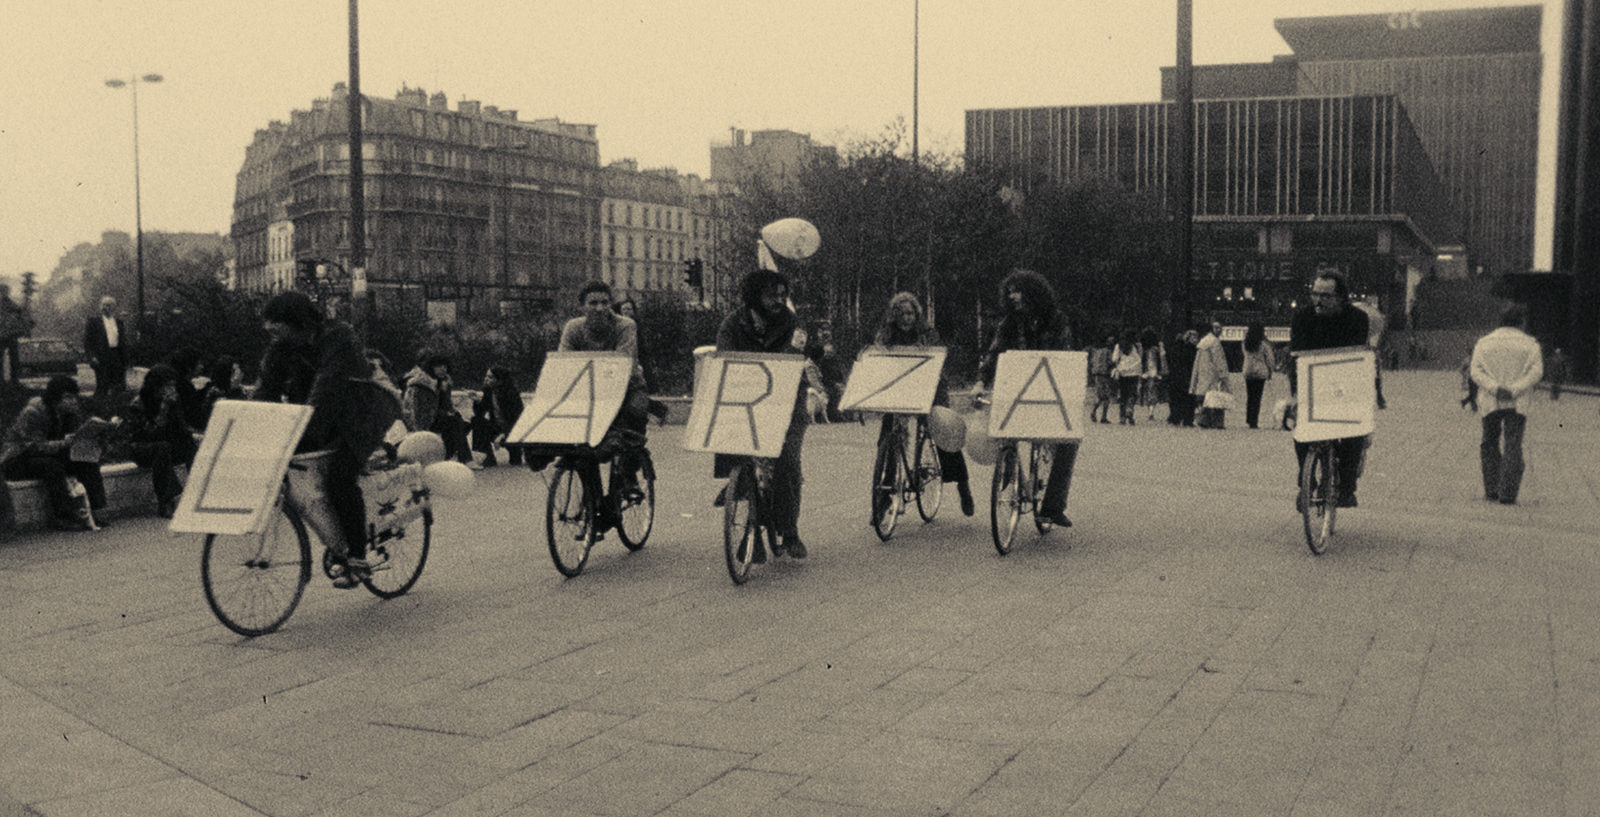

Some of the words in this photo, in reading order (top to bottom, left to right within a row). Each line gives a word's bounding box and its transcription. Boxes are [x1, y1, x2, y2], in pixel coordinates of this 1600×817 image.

[518, 359, 595, 443] A
[704, 360, 773, 450] R
[845, 354, 935, 411] Z
[1000, 356, 1072, 431] A
[1308, 357, 1365, 424] C
[194, 418, 253, 513] L
